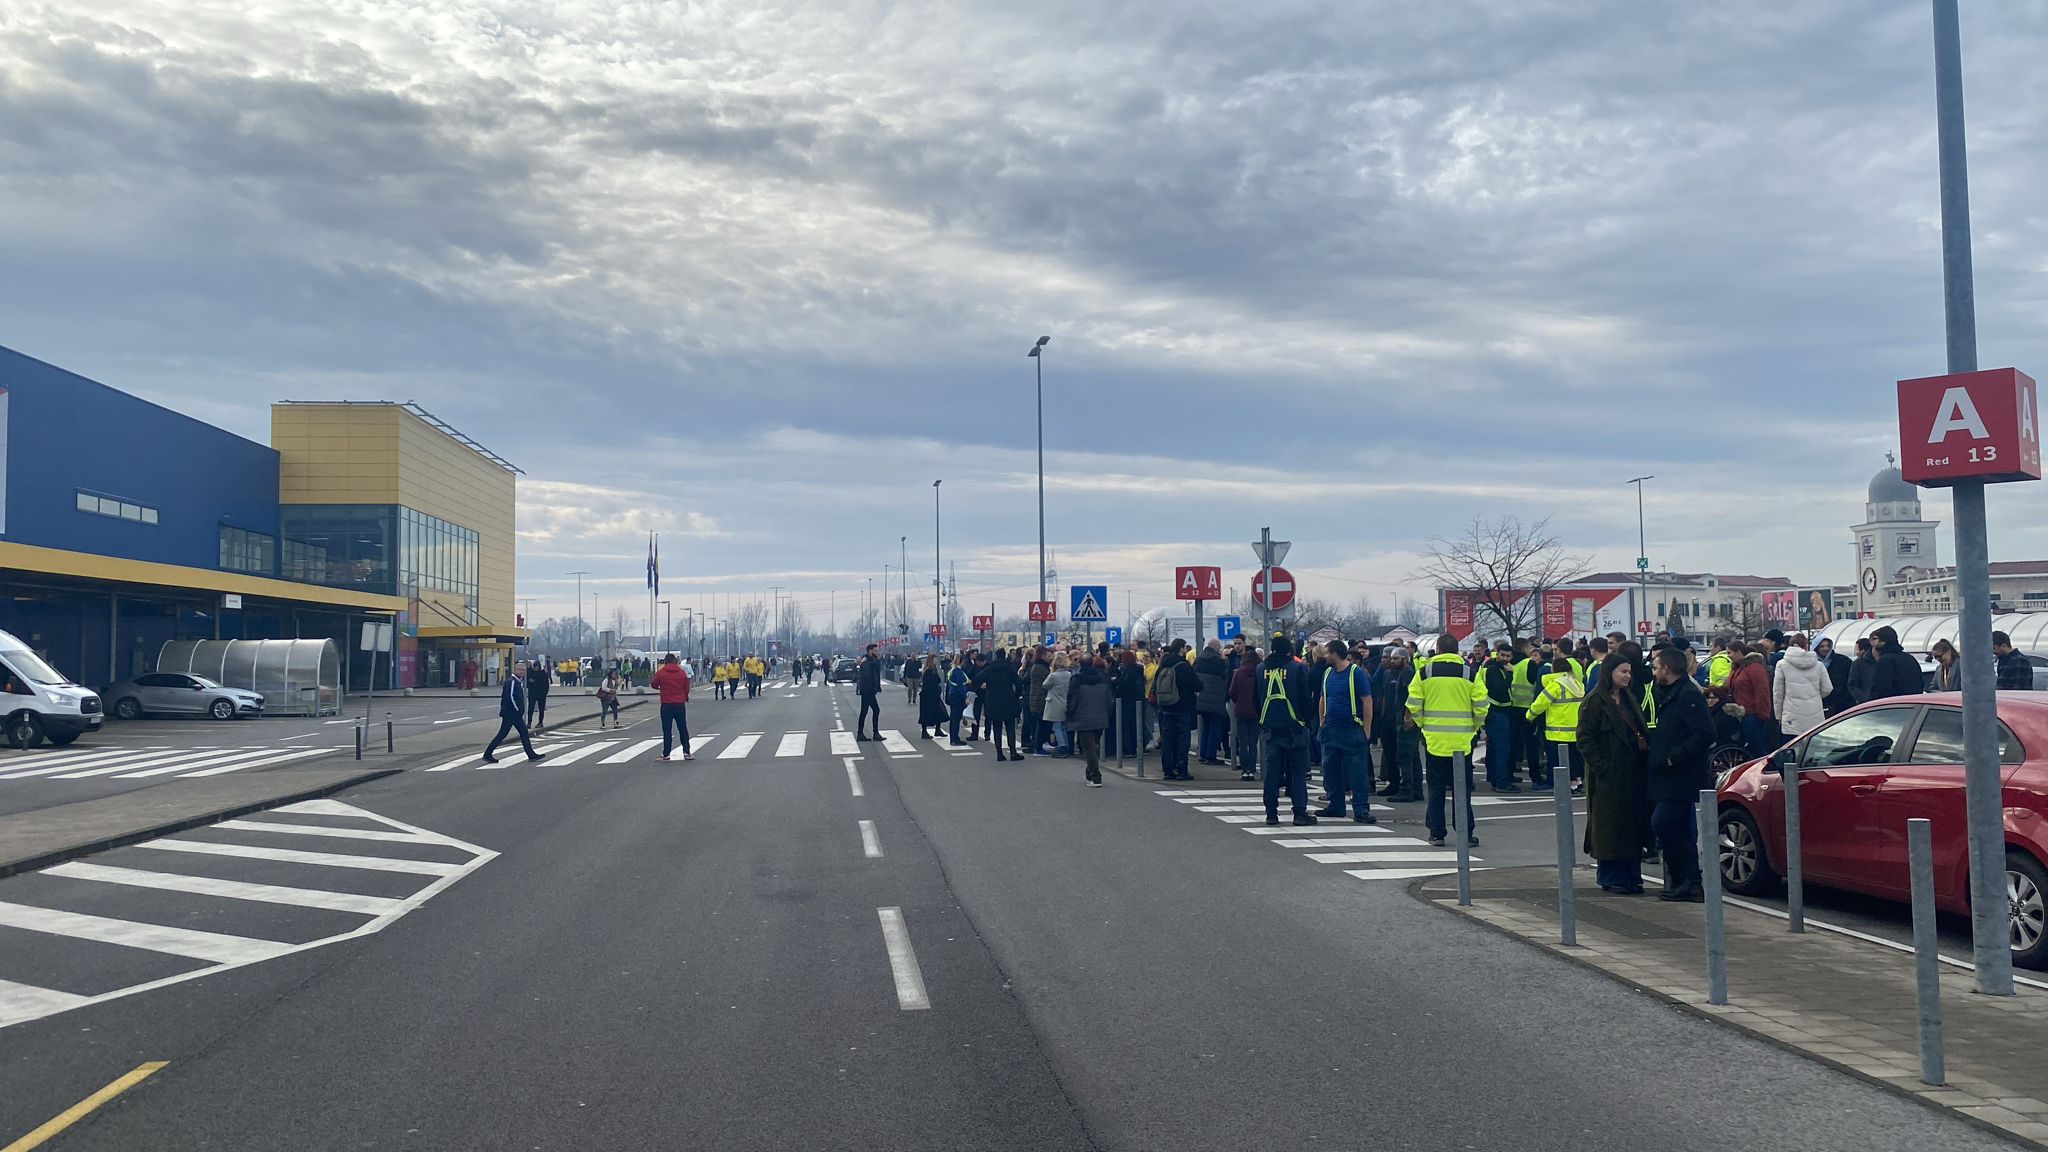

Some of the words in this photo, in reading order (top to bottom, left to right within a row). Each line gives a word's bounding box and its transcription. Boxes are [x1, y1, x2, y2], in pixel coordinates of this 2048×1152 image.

[1928, 386, 1990, 444] A
[2022, 387, 2035, 443] A
[1926, 456, 1949, 466] Red
[1968, 446, 1997, 463] 13
[1182, 570, 1198, 588] A
[1208, 570, 1217, 588] A
[1032, 604, 1041, 615] A
[1046, 604, 1054, 615] A
[975, 617, 981, 626] A
[985, 617, 991, 626] A
[1603, 620, 1612, 628] 26
[1224, 621, 1234, 635] P
[1046, 635, 1052, 646] P
[1110, 630, 1117, 641] P
